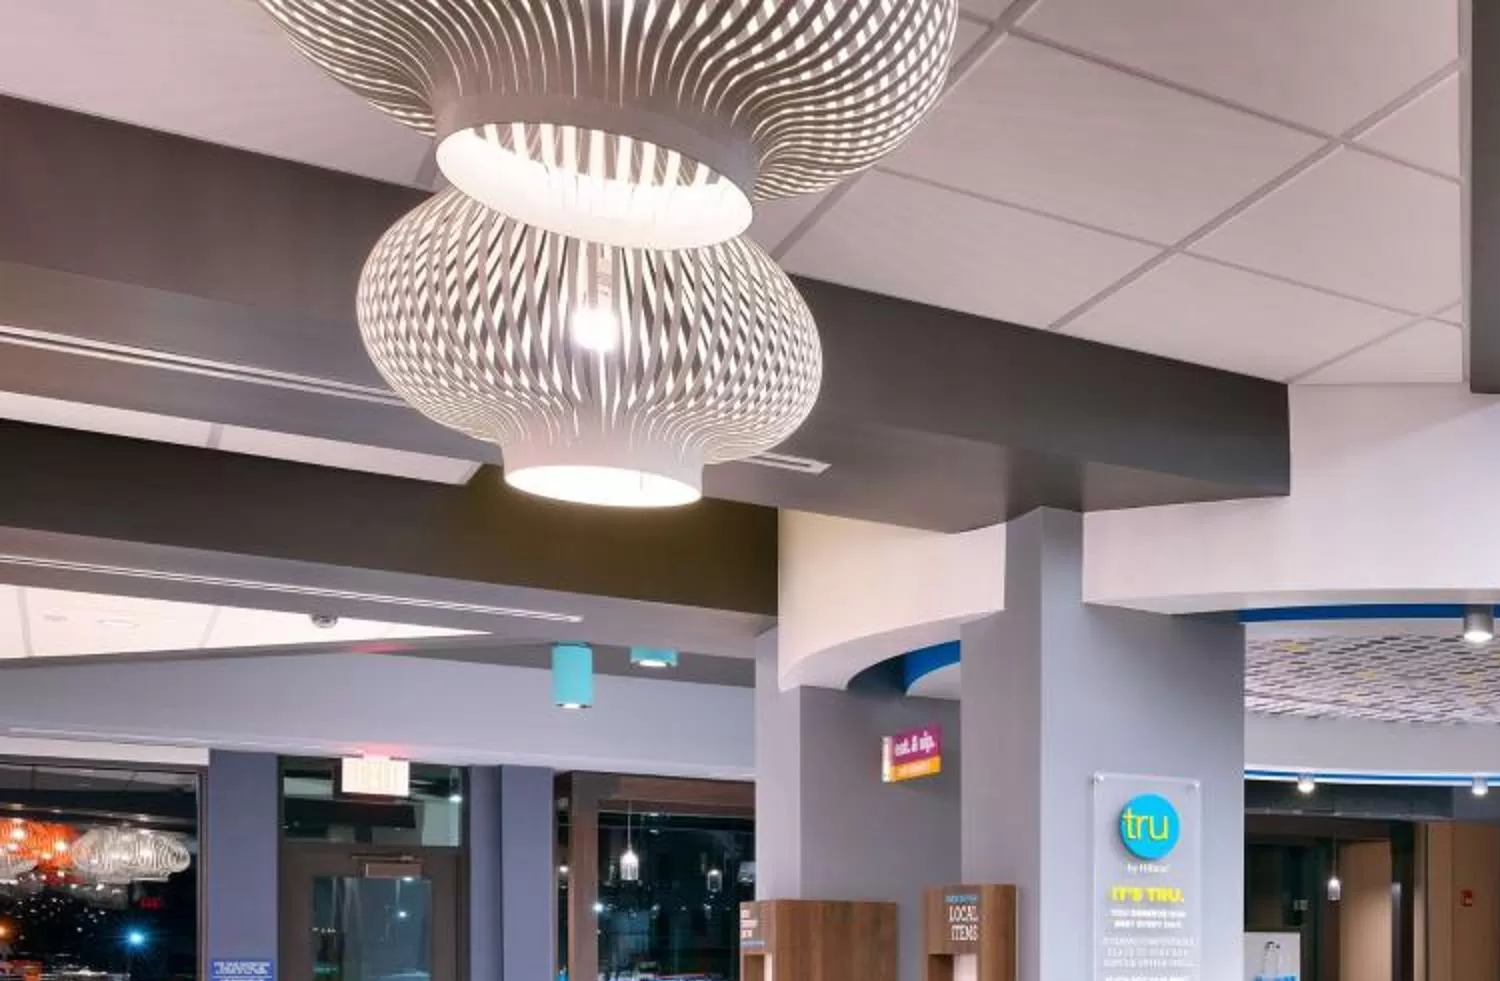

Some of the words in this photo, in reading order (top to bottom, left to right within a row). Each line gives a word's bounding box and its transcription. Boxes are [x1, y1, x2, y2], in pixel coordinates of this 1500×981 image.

[1121, 807, 1169, 840] tru
[949, 905, 979, 922] LOCAL
[951, 924, 978, 941] ITEMS
